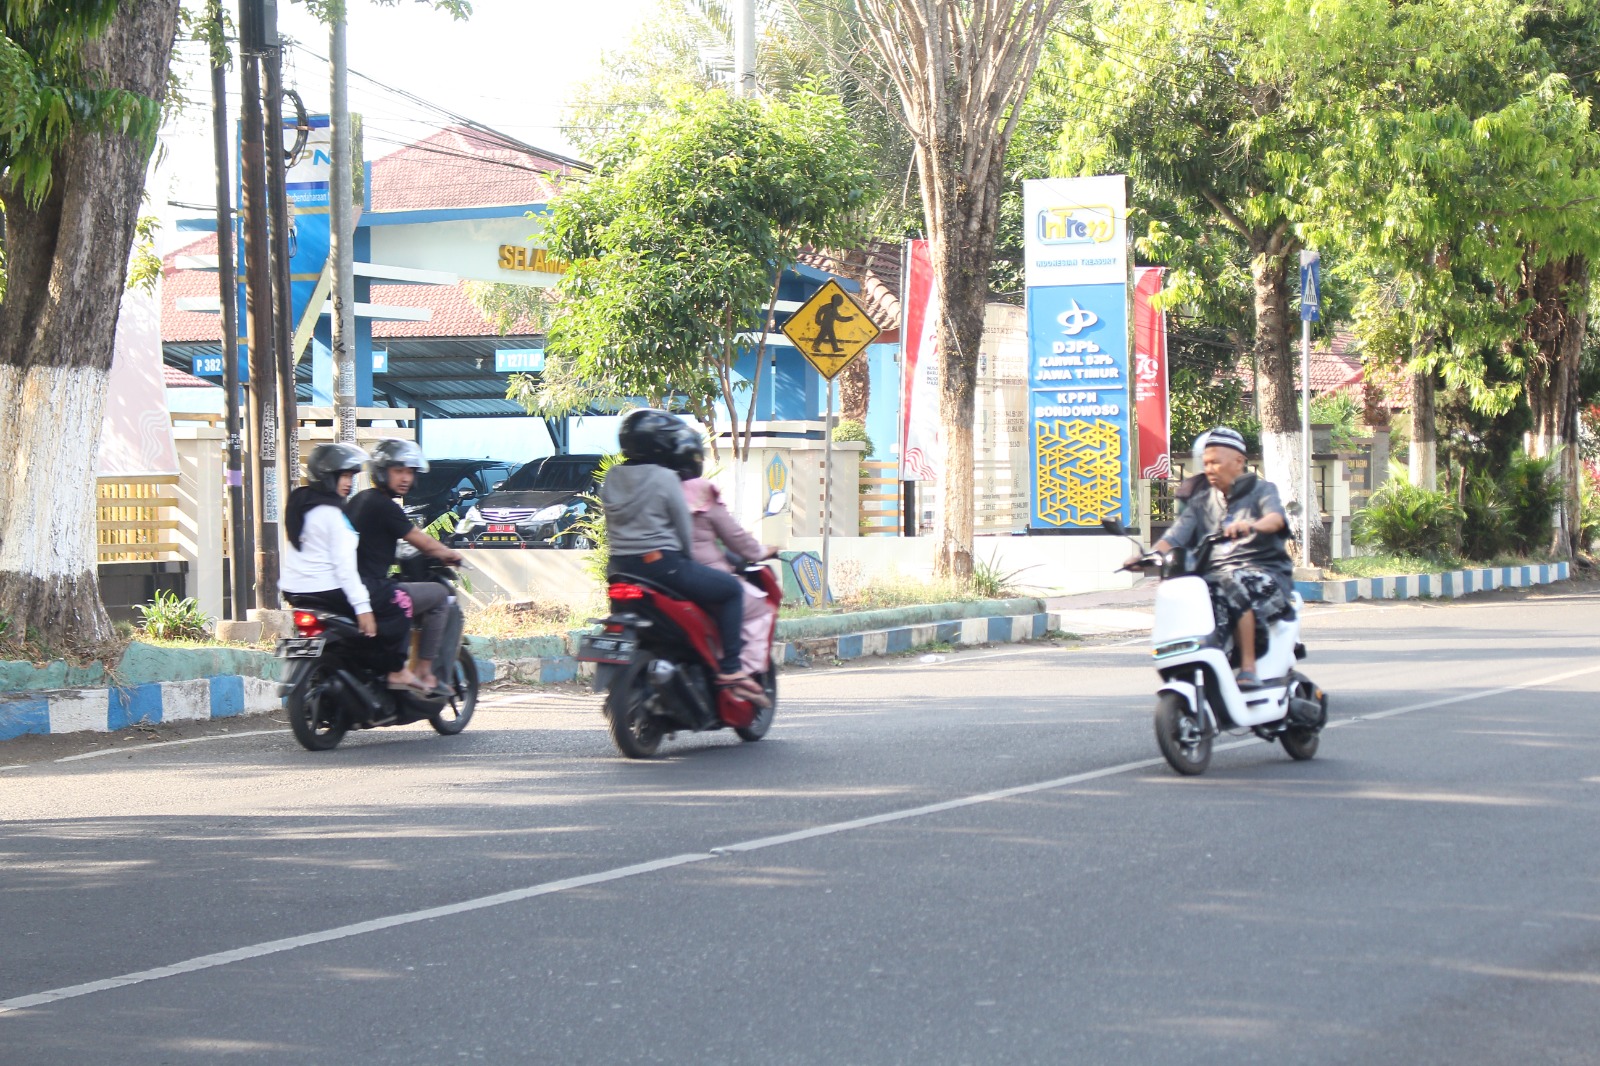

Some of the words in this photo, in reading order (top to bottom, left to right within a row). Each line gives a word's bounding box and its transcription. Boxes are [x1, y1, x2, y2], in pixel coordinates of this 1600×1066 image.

[498, 244, 571, 275] SELAMA
[1036, 259, 1078, 268] INDONESIAN
[1081, 257, 1117, 266] TREASURY
[1052, 340, 1100, 354] DJPb
[197, 359, 203, 372] P
[204, 357, 222, 372] 382
[498, 353, 506, 367] P
[1039, 355, 1084, 367] KANWIL
[1034, 369, 1073, 381] JAWA
[1074, 367, 1120, 379] TIMUR
[1057, 391, 1097, 404] KPPN
[1035, 404, 1120, 418] BONDOWOSO
